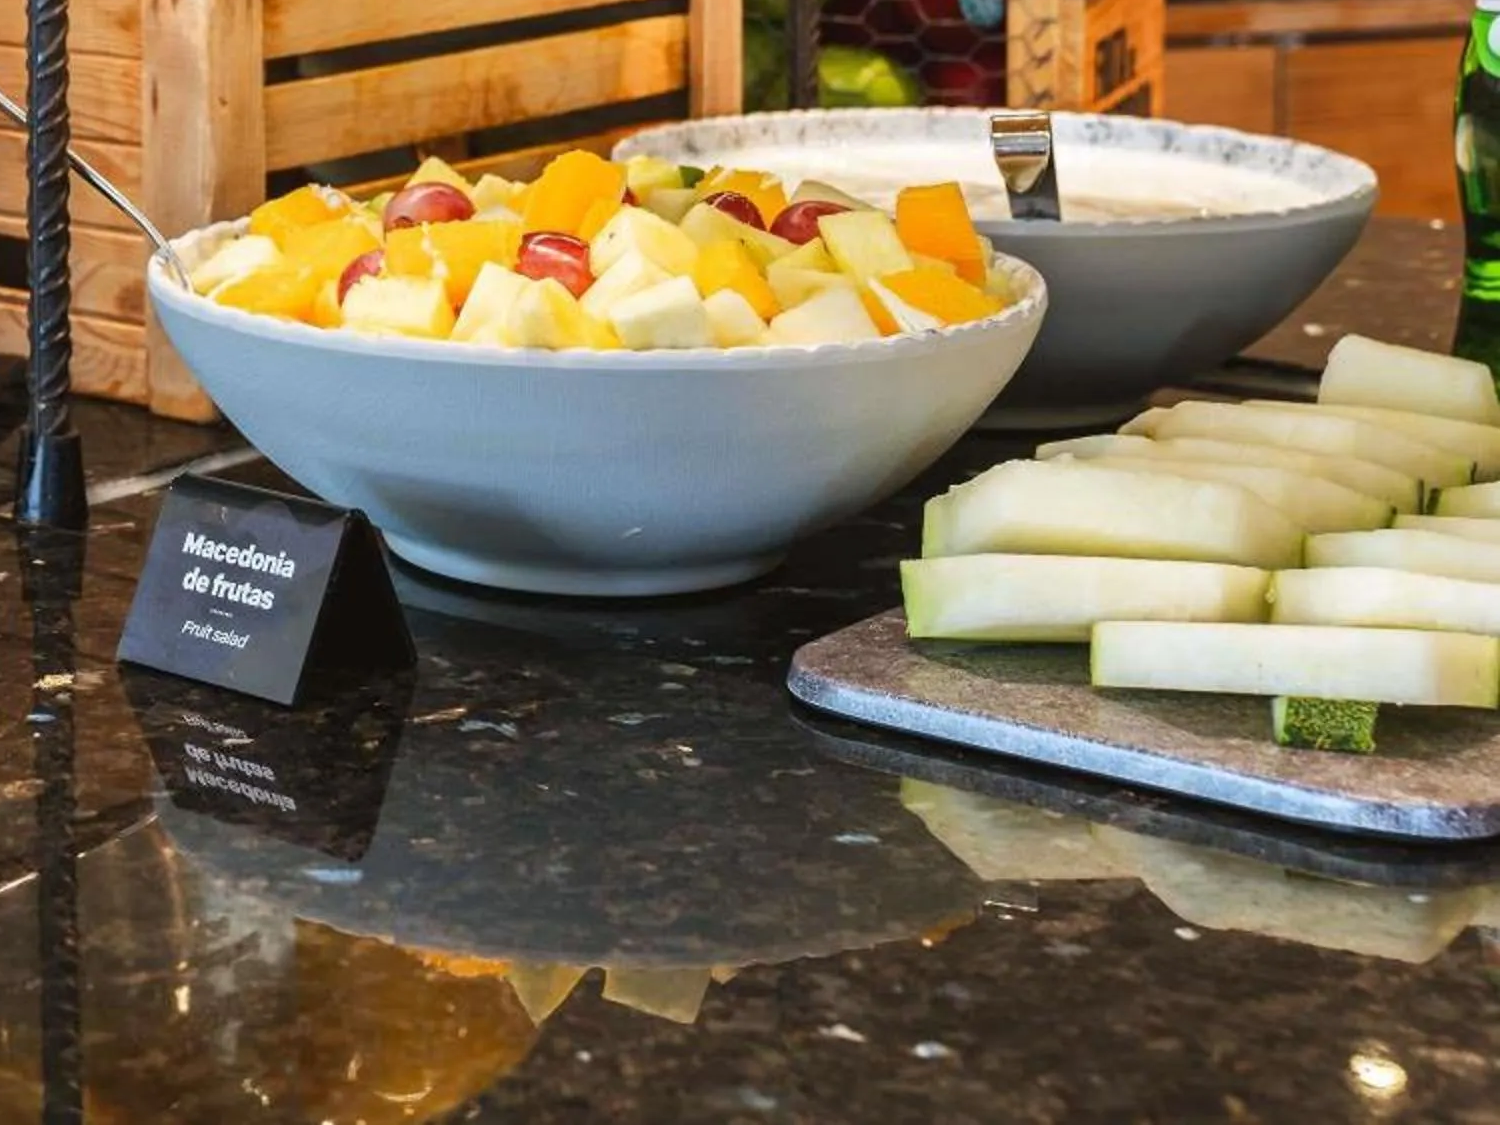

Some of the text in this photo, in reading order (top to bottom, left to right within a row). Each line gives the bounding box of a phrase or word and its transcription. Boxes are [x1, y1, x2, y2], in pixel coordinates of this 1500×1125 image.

[181, 532, 296, 578] Macedonia
[181, 566, 275, 610] de frutas
[181, 620, 251, 648] Fruit salad
